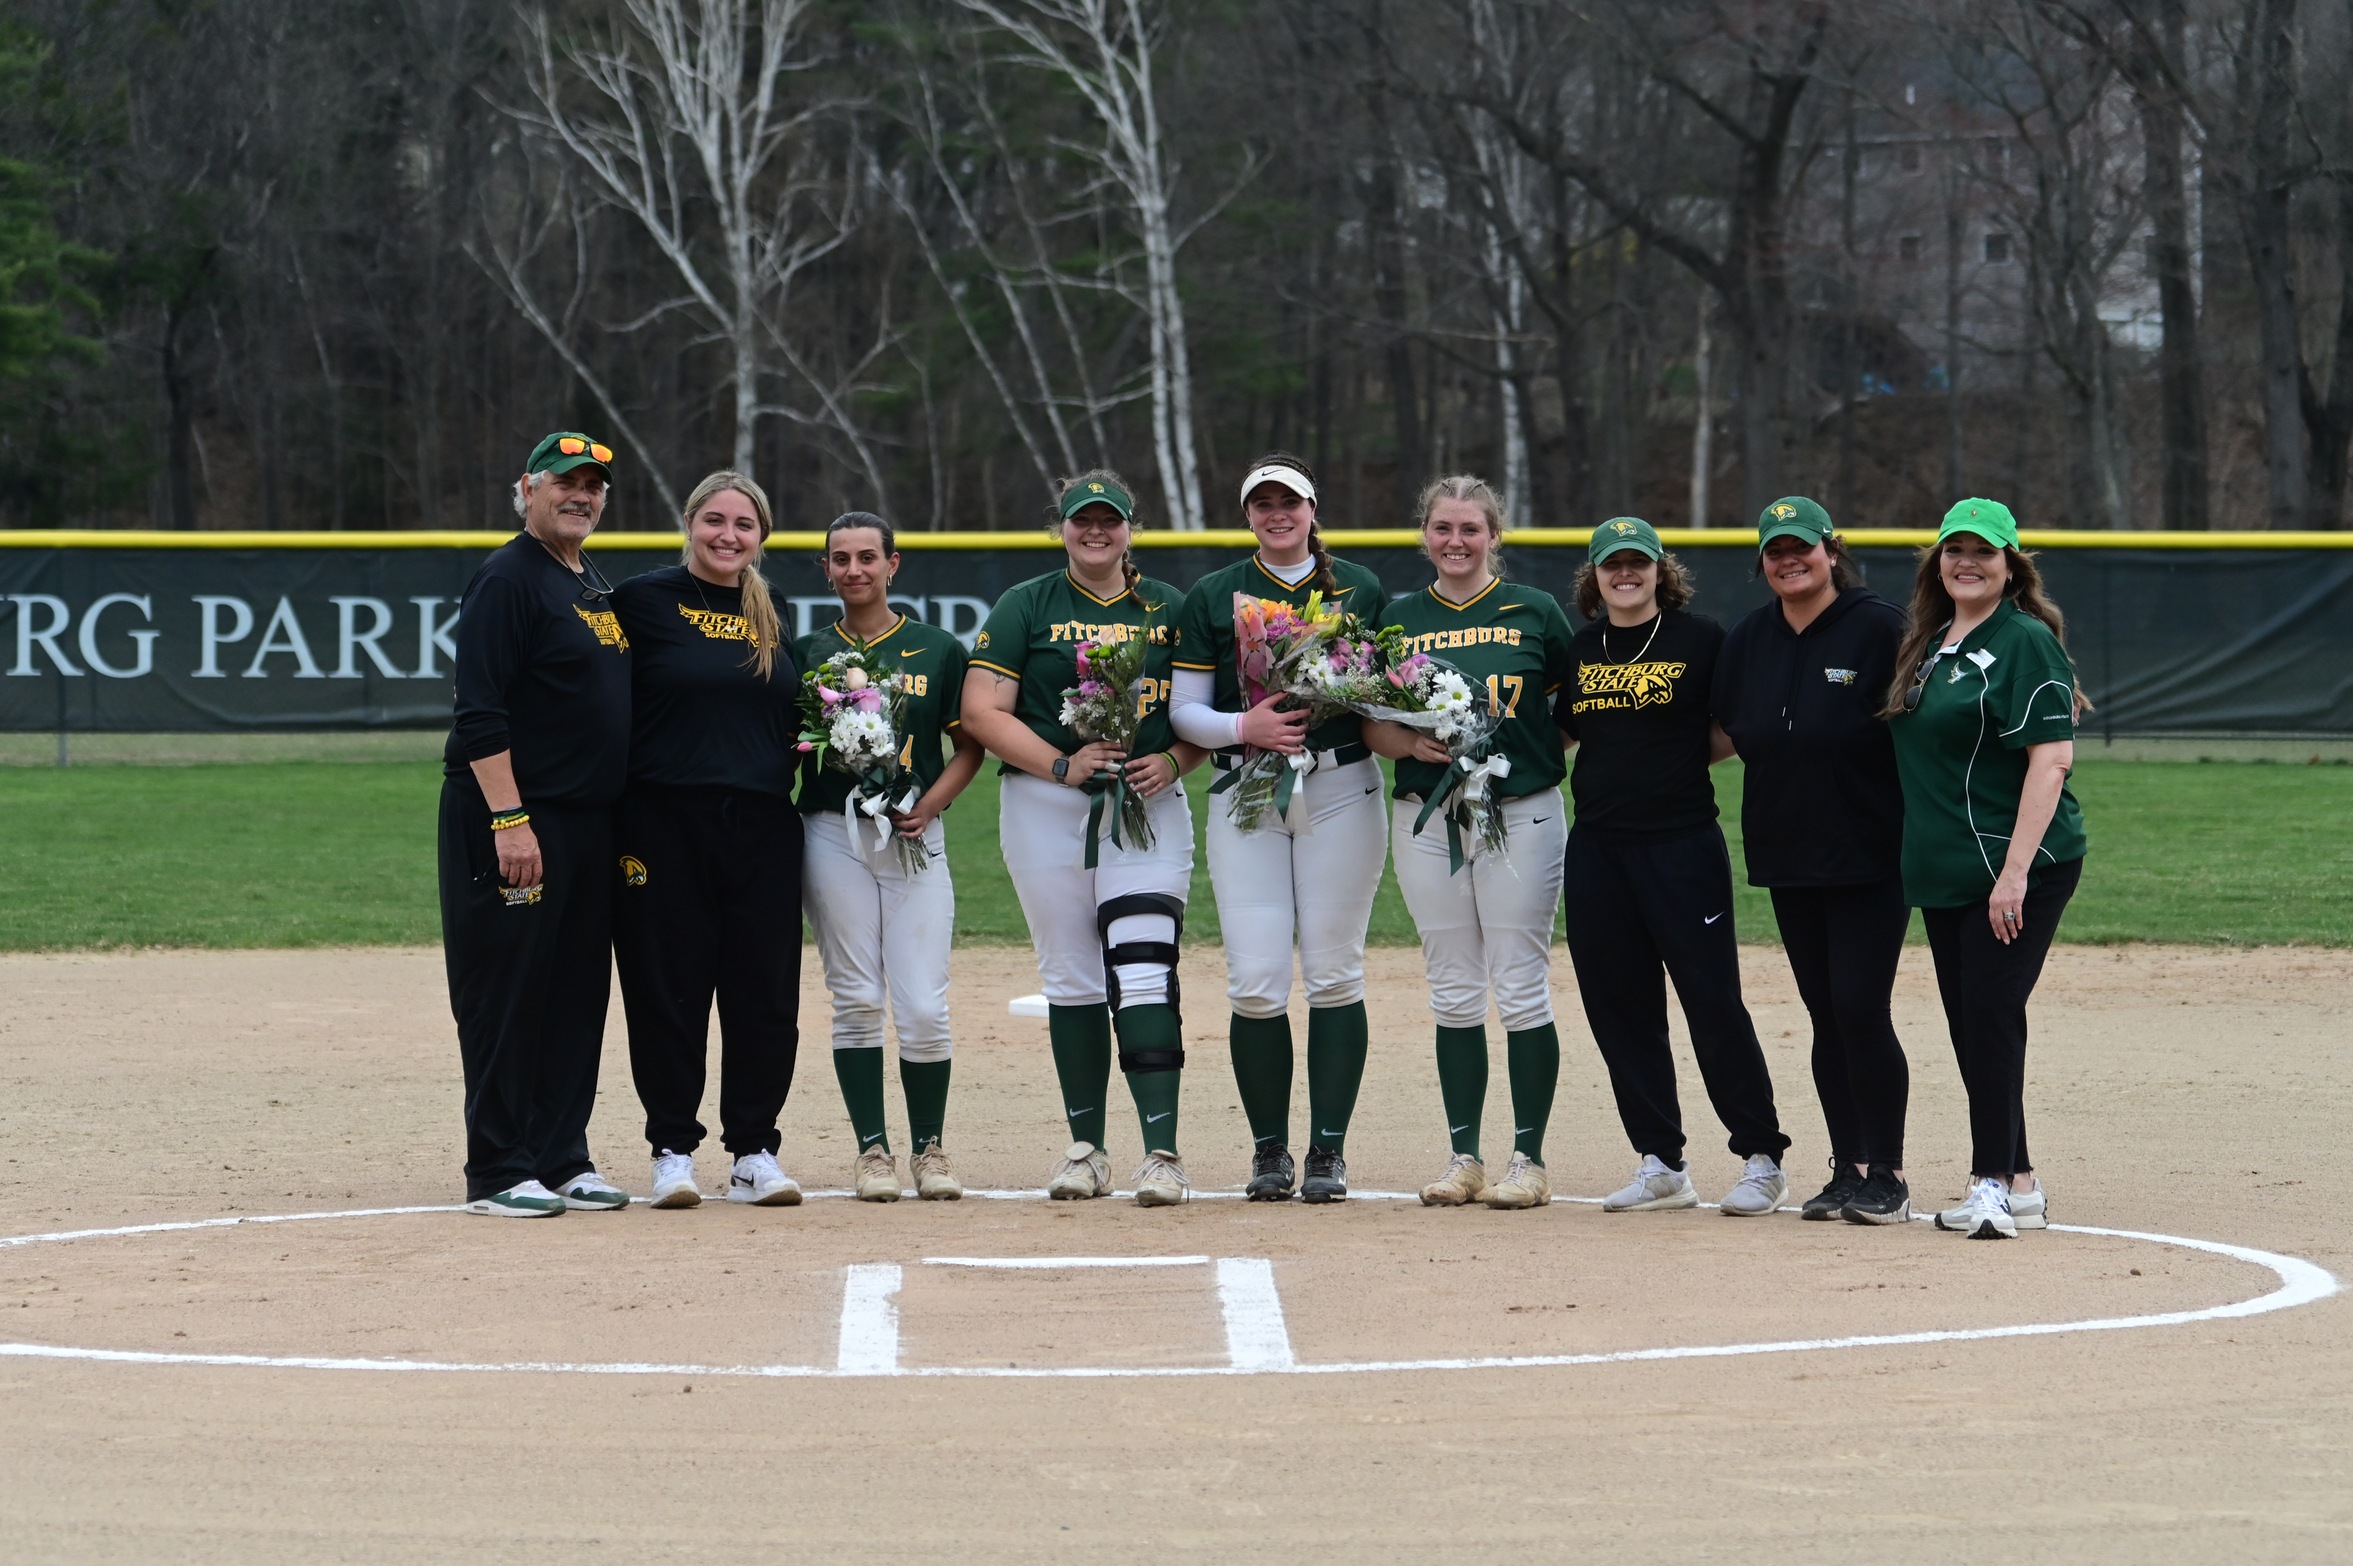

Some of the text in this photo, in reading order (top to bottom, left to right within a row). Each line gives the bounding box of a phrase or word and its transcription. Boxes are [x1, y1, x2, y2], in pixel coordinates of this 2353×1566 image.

[0, 592, 459, 678] RG PARK
[701, 623, 750, 634] STATE
[705, 632, 745, 640] SOFTBALL
[1400, 626, 1522, 656] FITCHBURG
[1581, 663, 1684, 684] FITCHBURG
[1583, 676, 1639, 692] STATE
[1486, 674, 1523, 718] 17
[1572, 696, 1631, 715] SOFTBALL
